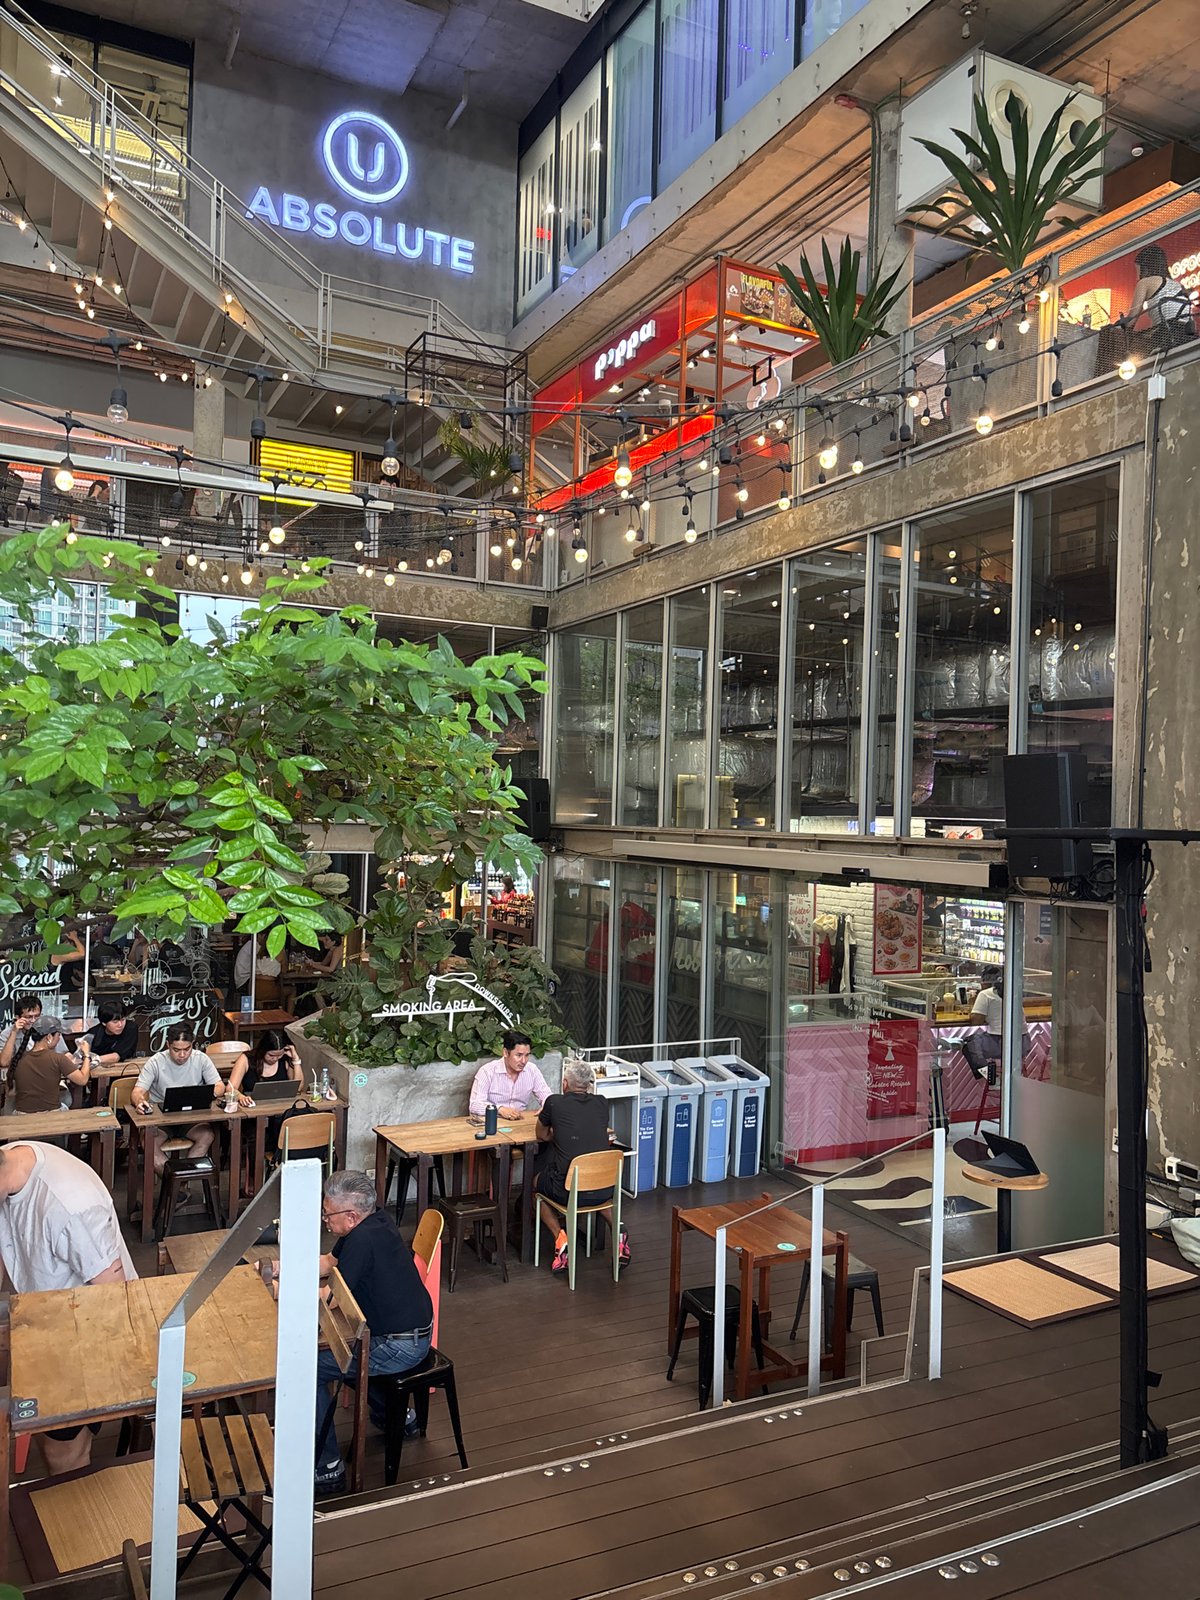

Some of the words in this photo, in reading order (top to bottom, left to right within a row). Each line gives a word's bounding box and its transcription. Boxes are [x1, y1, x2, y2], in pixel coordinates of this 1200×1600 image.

[245, 186, 475, 275] ABSOLUTE
[0, 963, 62, 1000] Second
[166, 989, 209, 1020] Feast
[382, 1000, 442, 1014] SMOKING
[445, 999, 476, 1010] AREA
[474, 983, 514, 1020] DOWNSTAIRS
